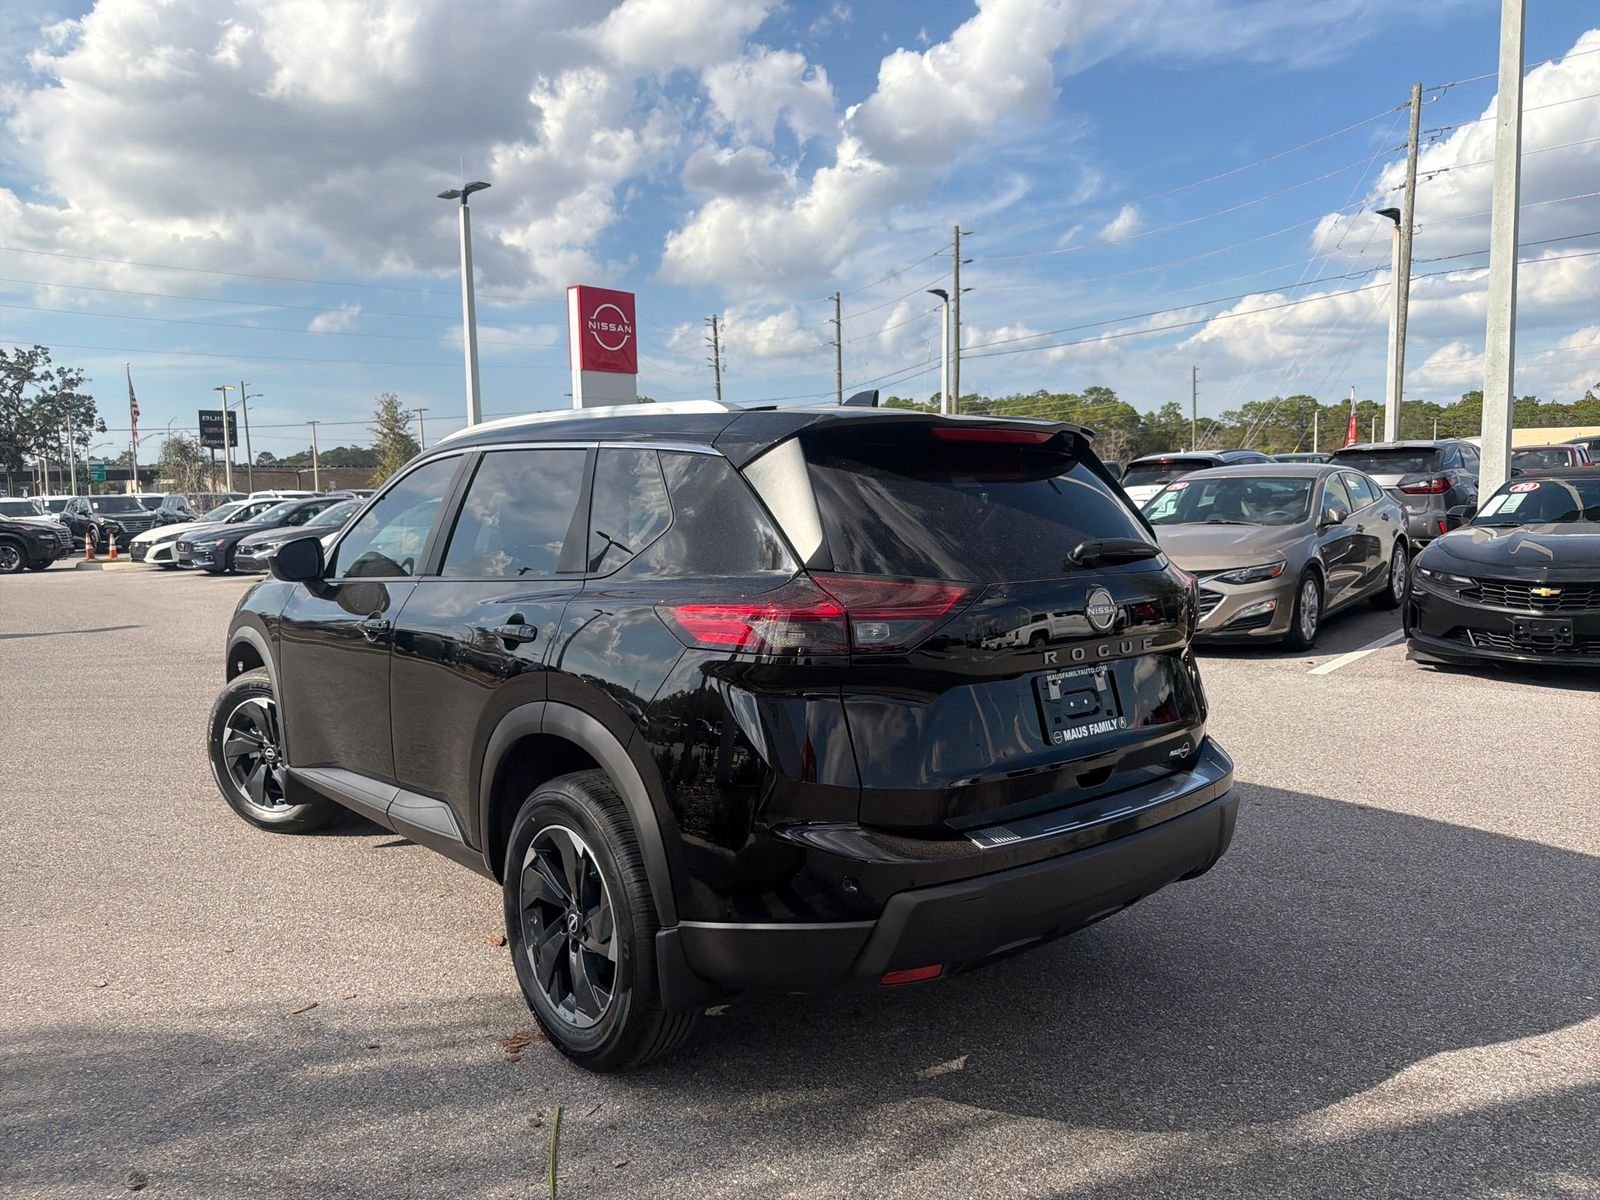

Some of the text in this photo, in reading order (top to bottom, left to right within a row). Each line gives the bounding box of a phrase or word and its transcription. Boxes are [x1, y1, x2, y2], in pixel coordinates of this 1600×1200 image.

[588, 321, 632, 334] NISSAN
[1087, 606, 1118, 615] NISSAN
[1044, 639, 1153, 665] ROGUE
[1046, 665, 1108, 680] MAUSFAMILYAUTO.COM
[1063, 718, 1118, 741] MAUS FAMILY
